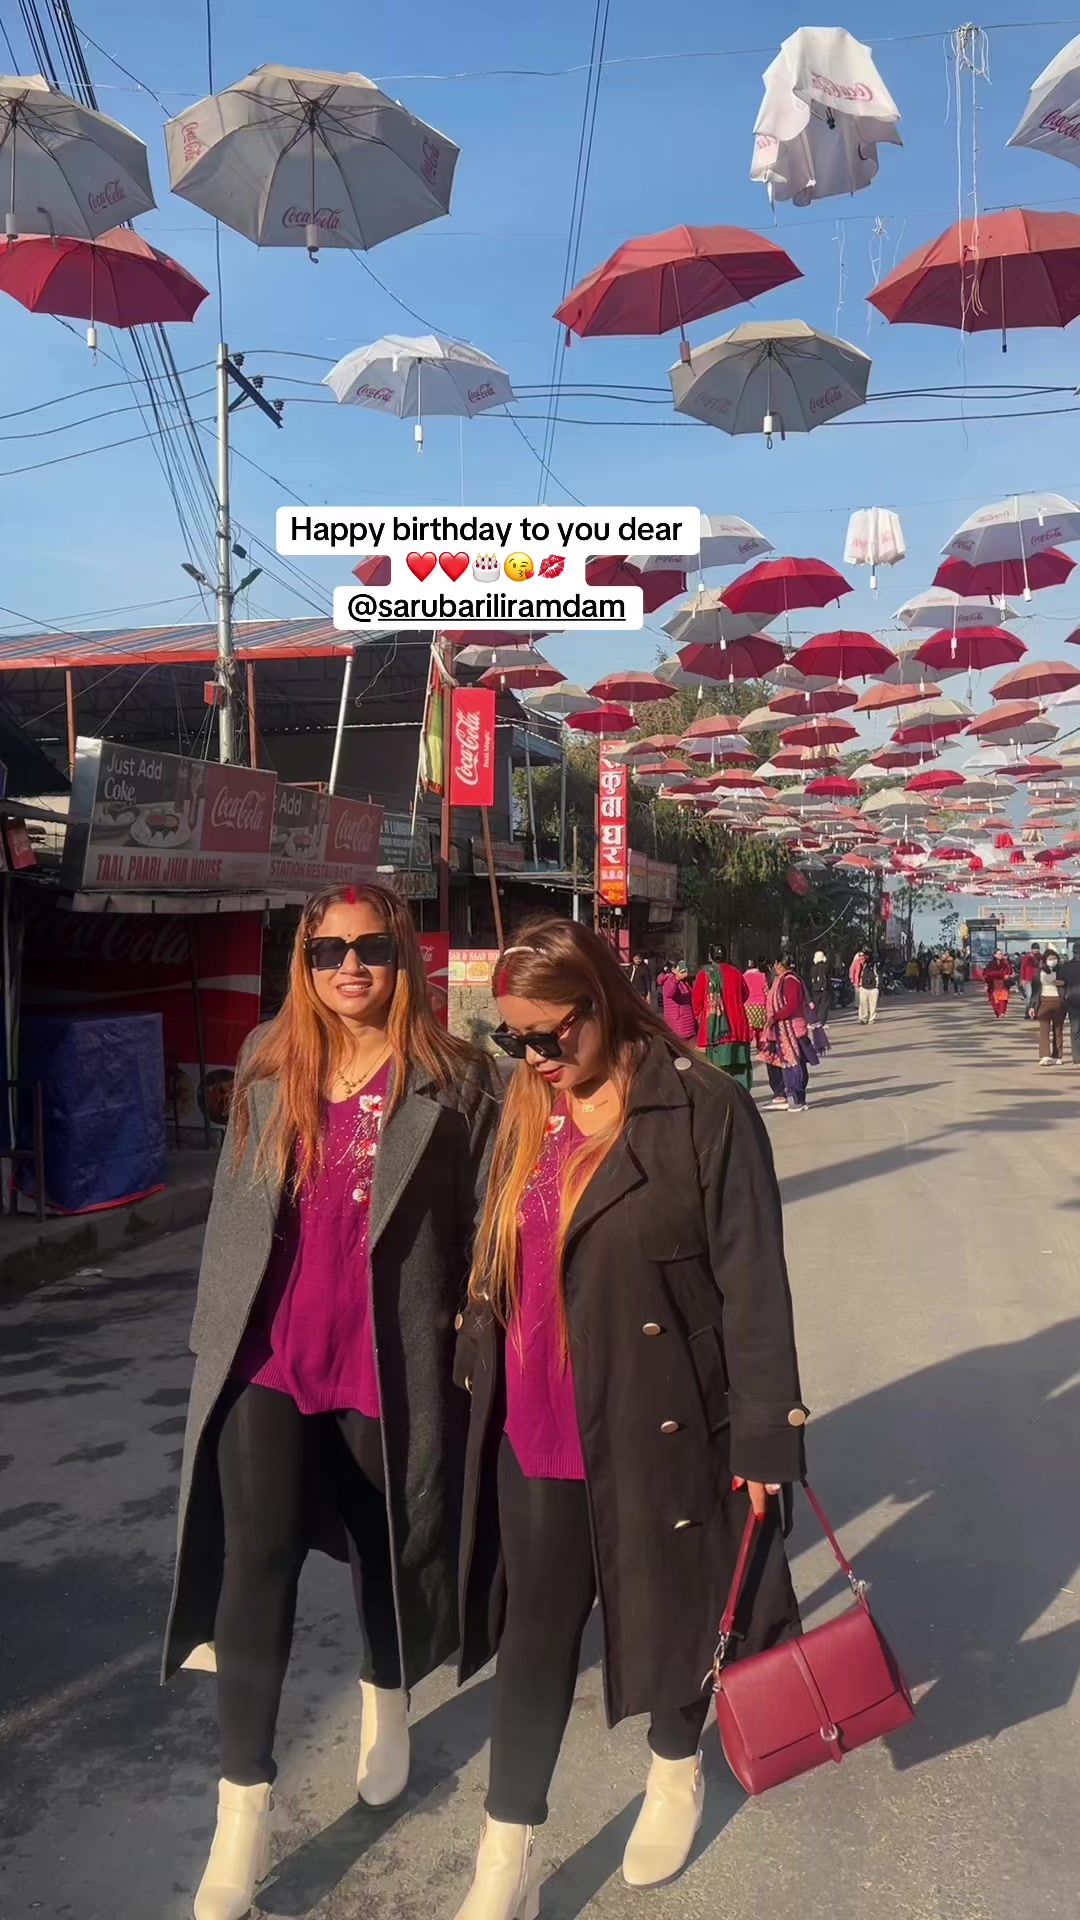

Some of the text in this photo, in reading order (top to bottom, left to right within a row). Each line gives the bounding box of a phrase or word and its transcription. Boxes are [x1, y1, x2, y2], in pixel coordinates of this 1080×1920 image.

[483, 731, 491, 751] Magic
[106, 752, 163, 780] Just Add
[104, 777, 136, 801] Coke
[279, 791, 303, 816] Add
